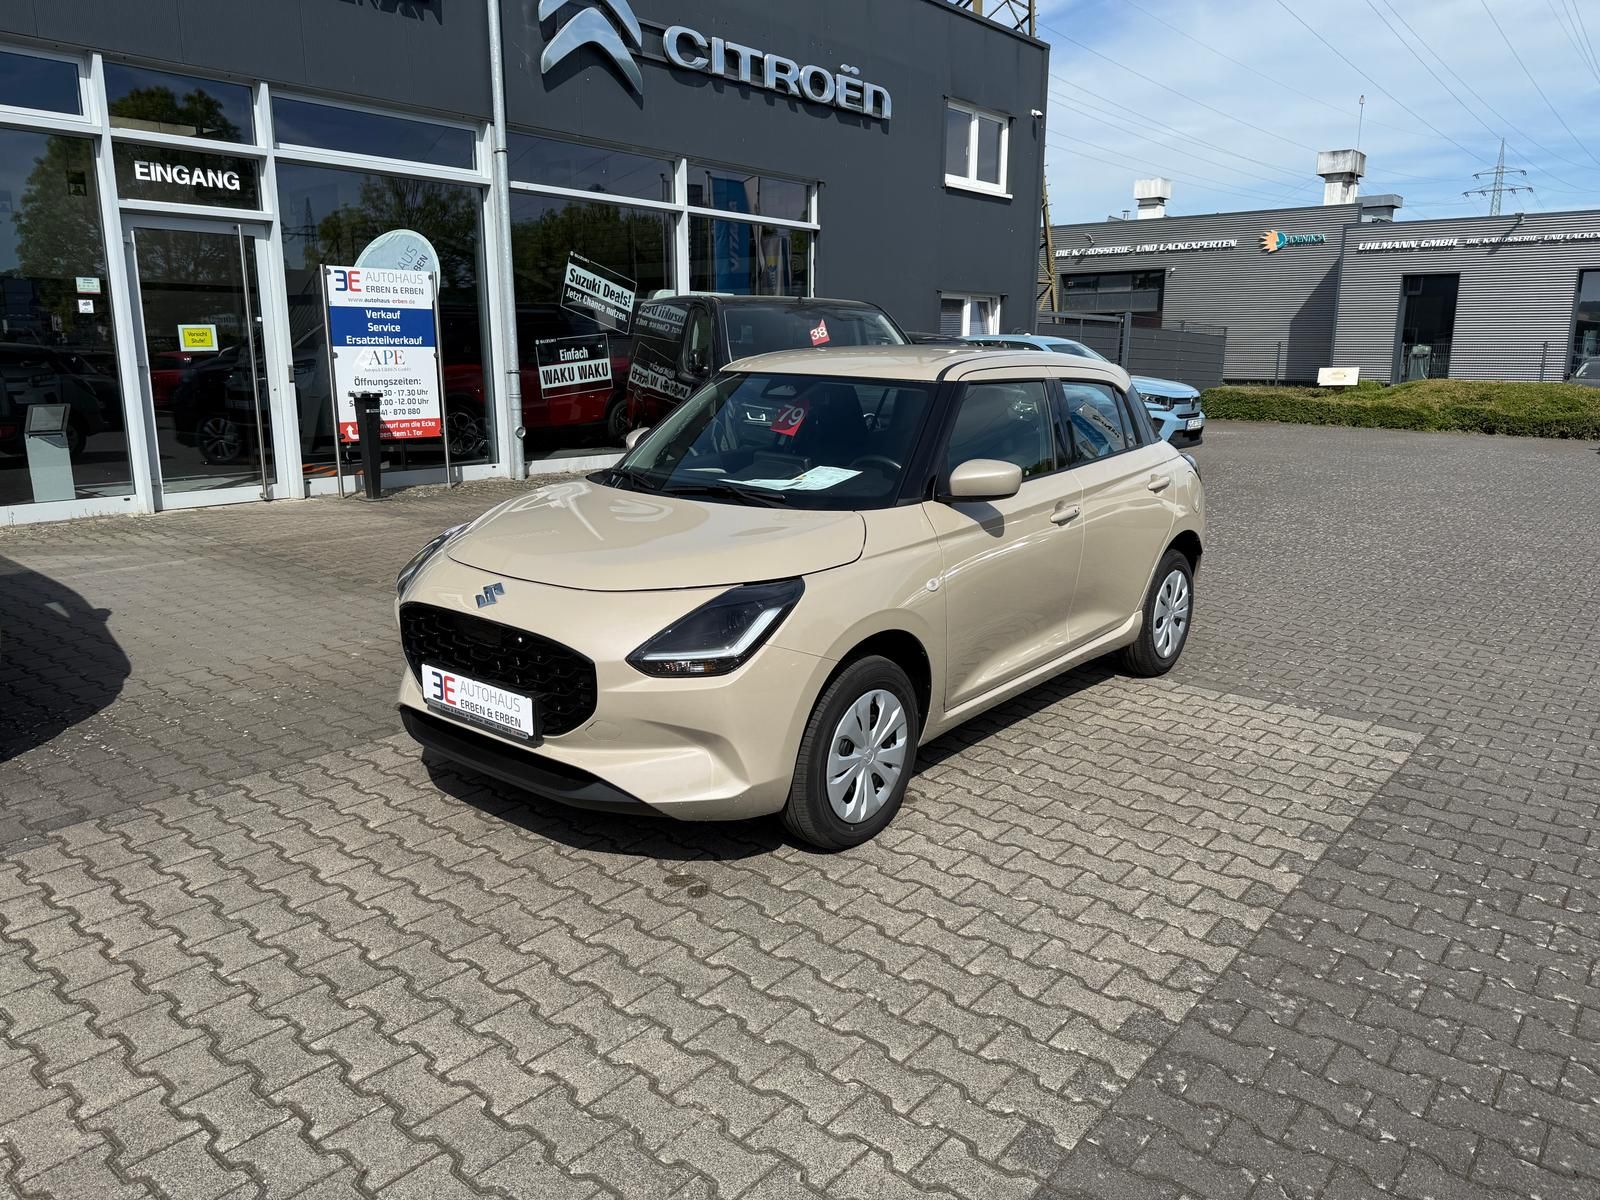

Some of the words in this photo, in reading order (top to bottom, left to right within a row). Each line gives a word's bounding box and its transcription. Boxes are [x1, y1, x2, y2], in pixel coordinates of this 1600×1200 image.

[663, 25, 892, 120] CITROËN
[134, 160, 240, 191] EINGANG
[1543, 233, 1564, 241] UND
[1055, 249, 1071, 257] DIE
[1136, 244, 1157, 252] UND
[1159, 239, 1238, 251] LACKEXPERTEN
[1358, 241, 1420, 251] UHLMANN
[1421, 238, 1459, 248] GMBH
[413, 254, 429, 271] BEN
[366, 271, 424, 285] AUTOHAUS
[366, 285, 391, 294] ERBEN
[393, 286, 399, 294] &
[400, 287, 424, 295] ERBEN
[568, 268, 602, 290] Suzuki
[603, 281, 632, 308] Deals!
[566, 288, 582, 302] Jetzt
[583, 293, 606, 312] Chance
[606, 306, 628, 322] nutzen.
[365, 309, 401, 319] Verkauf
[367, 323, 401, 332] Service
[810, 326, 828, 340] 38
[346, 335, 422, 345] Ersatzteilverkauf
[369, 350, 406, 366] APE
[559, 347, 589, 361] Einfach
[542, 366, 575, 385] WAKU
[578, 362, 609, 382] WAKU
[354, 376, 422, 388] Öffnungszeiten:
[397, 389, 417, 397] 17.30
[417, 388, 429, 396] Uhr
[398, 398, 417, 406] 12.00
[417, 397, 429, 405] Uhr
[407, 407, 421, 415] 880
[778, 404, 805, 426] 79
[410, 420, 421, 428] die
[460, 680, 521, 713] AUTOHAUS
[460, 699, 486, 716] ERBEN
[487, 709, 494, 719] &
[495, 711, 522, 728] ERBEN
